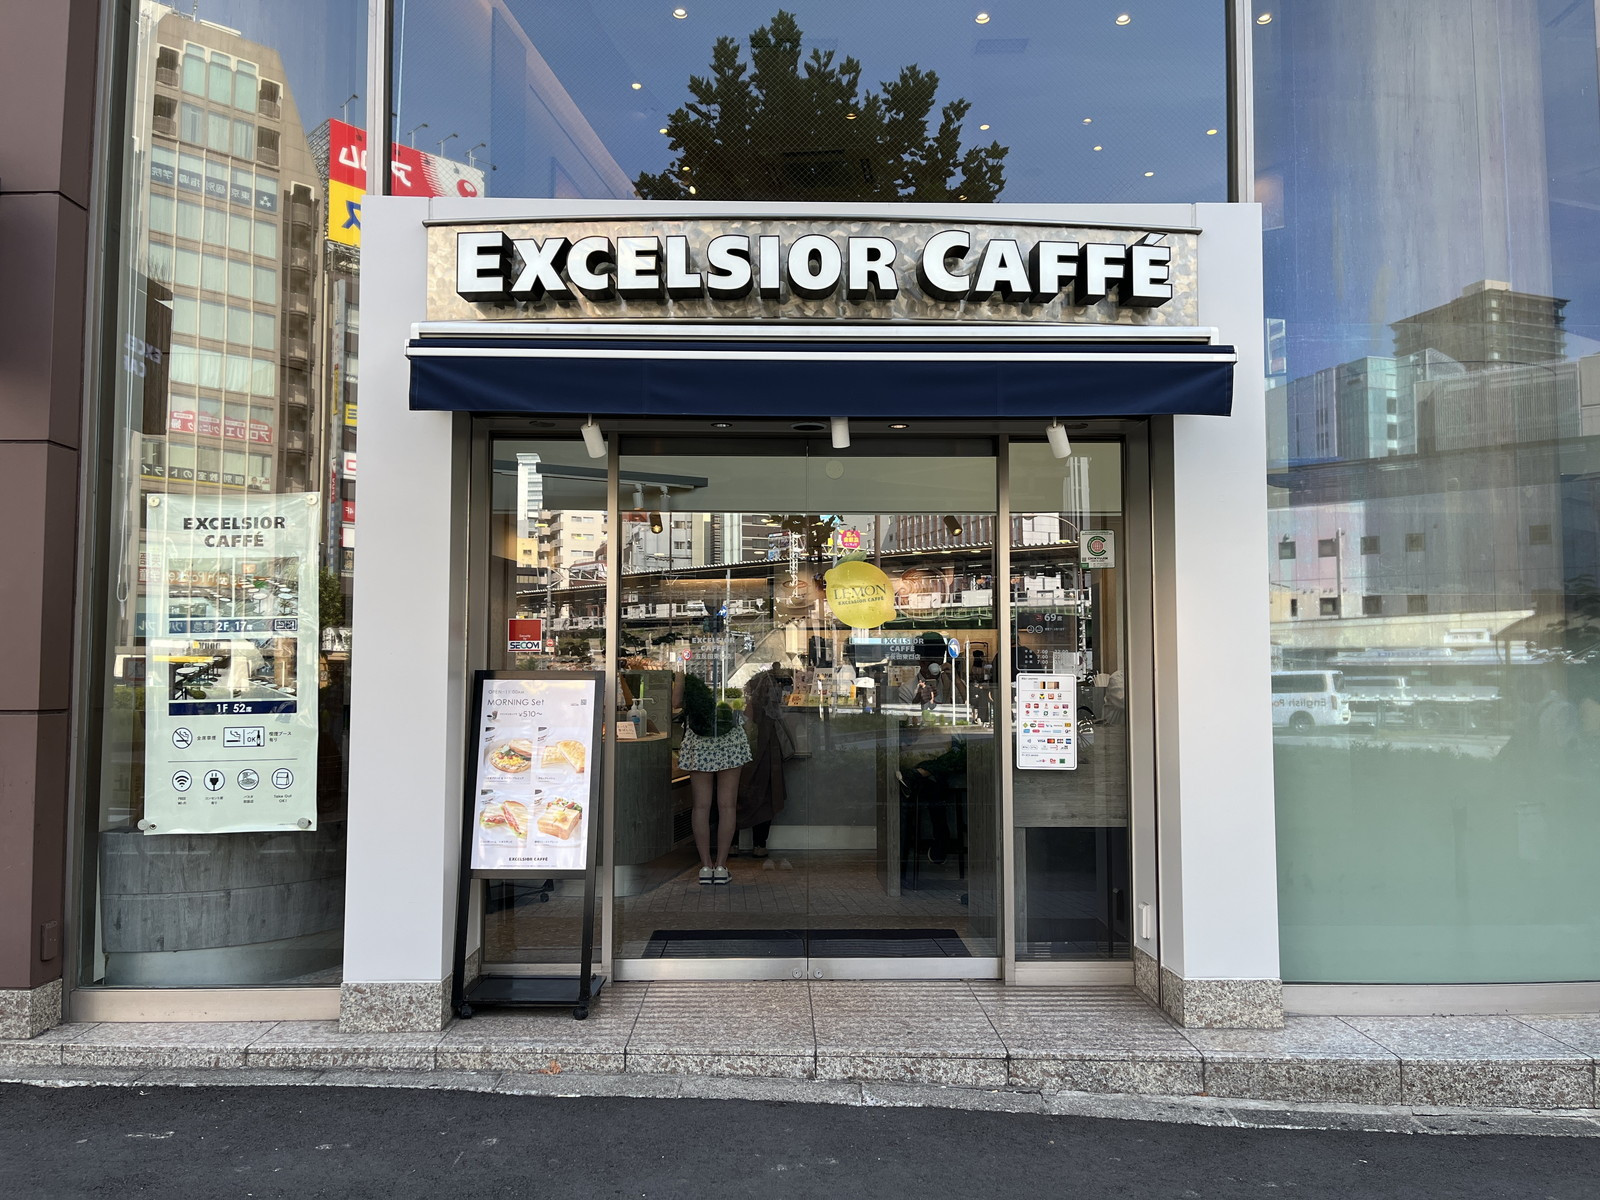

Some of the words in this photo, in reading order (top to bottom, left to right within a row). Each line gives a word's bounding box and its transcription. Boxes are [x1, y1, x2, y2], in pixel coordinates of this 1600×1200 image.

[454, 230, 899, 301] EXCELSIOR
[918, 230, 1174, 306] CAFFÉ
[183, 516, 286, 530] EXCELSIOR
[204, 531, 264, 548] CAFFÉ
[833, 584, 887, 600] LEMON
[216, 621, 229, 631] 2F
[510, 641, 540, 649] SECOM
[487, 698, 529, 706] MORNING
[531, 698, 545, 706] Set
[217, 704, 229, 713] 1F
